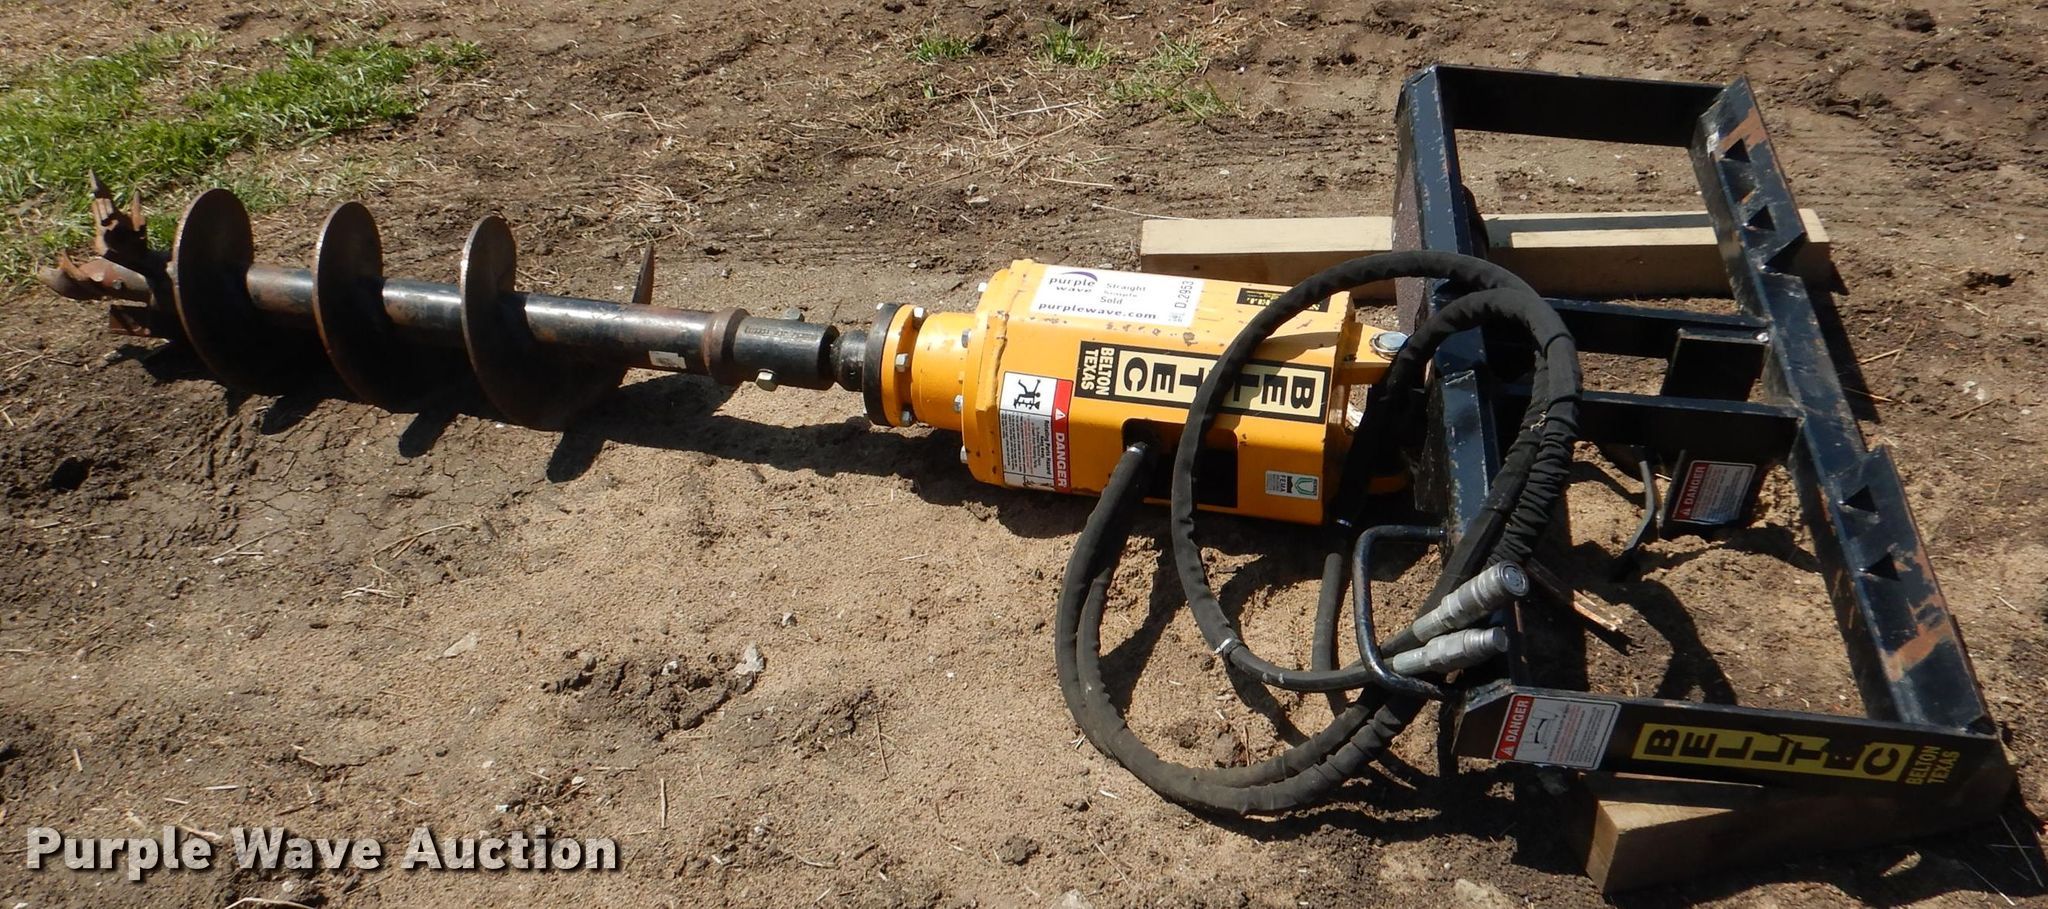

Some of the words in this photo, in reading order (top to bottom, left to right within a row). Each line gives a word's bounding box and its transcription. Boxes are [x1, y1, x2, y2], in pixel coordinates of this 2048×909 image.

[1049, 277, 1096, 287] purple
[1100, 296, 1124, 305] Sold
[1039, 302, 1156, 319] purplewave.com
[1081, 349, 1099, 391] TEXAS
[1095, 347, 1115, 396] BELTON
[1123, 356, 1317, 410] BELTEC
[1055, 432, 1068, 488] DANGER
[1684, 466, 1706, 505] DANGER
[1505, 700, 1529, 743] DANGER
[1905, 745, 1941, 786] BELTON
[1927, 750, 1961, 785] TEXAS
